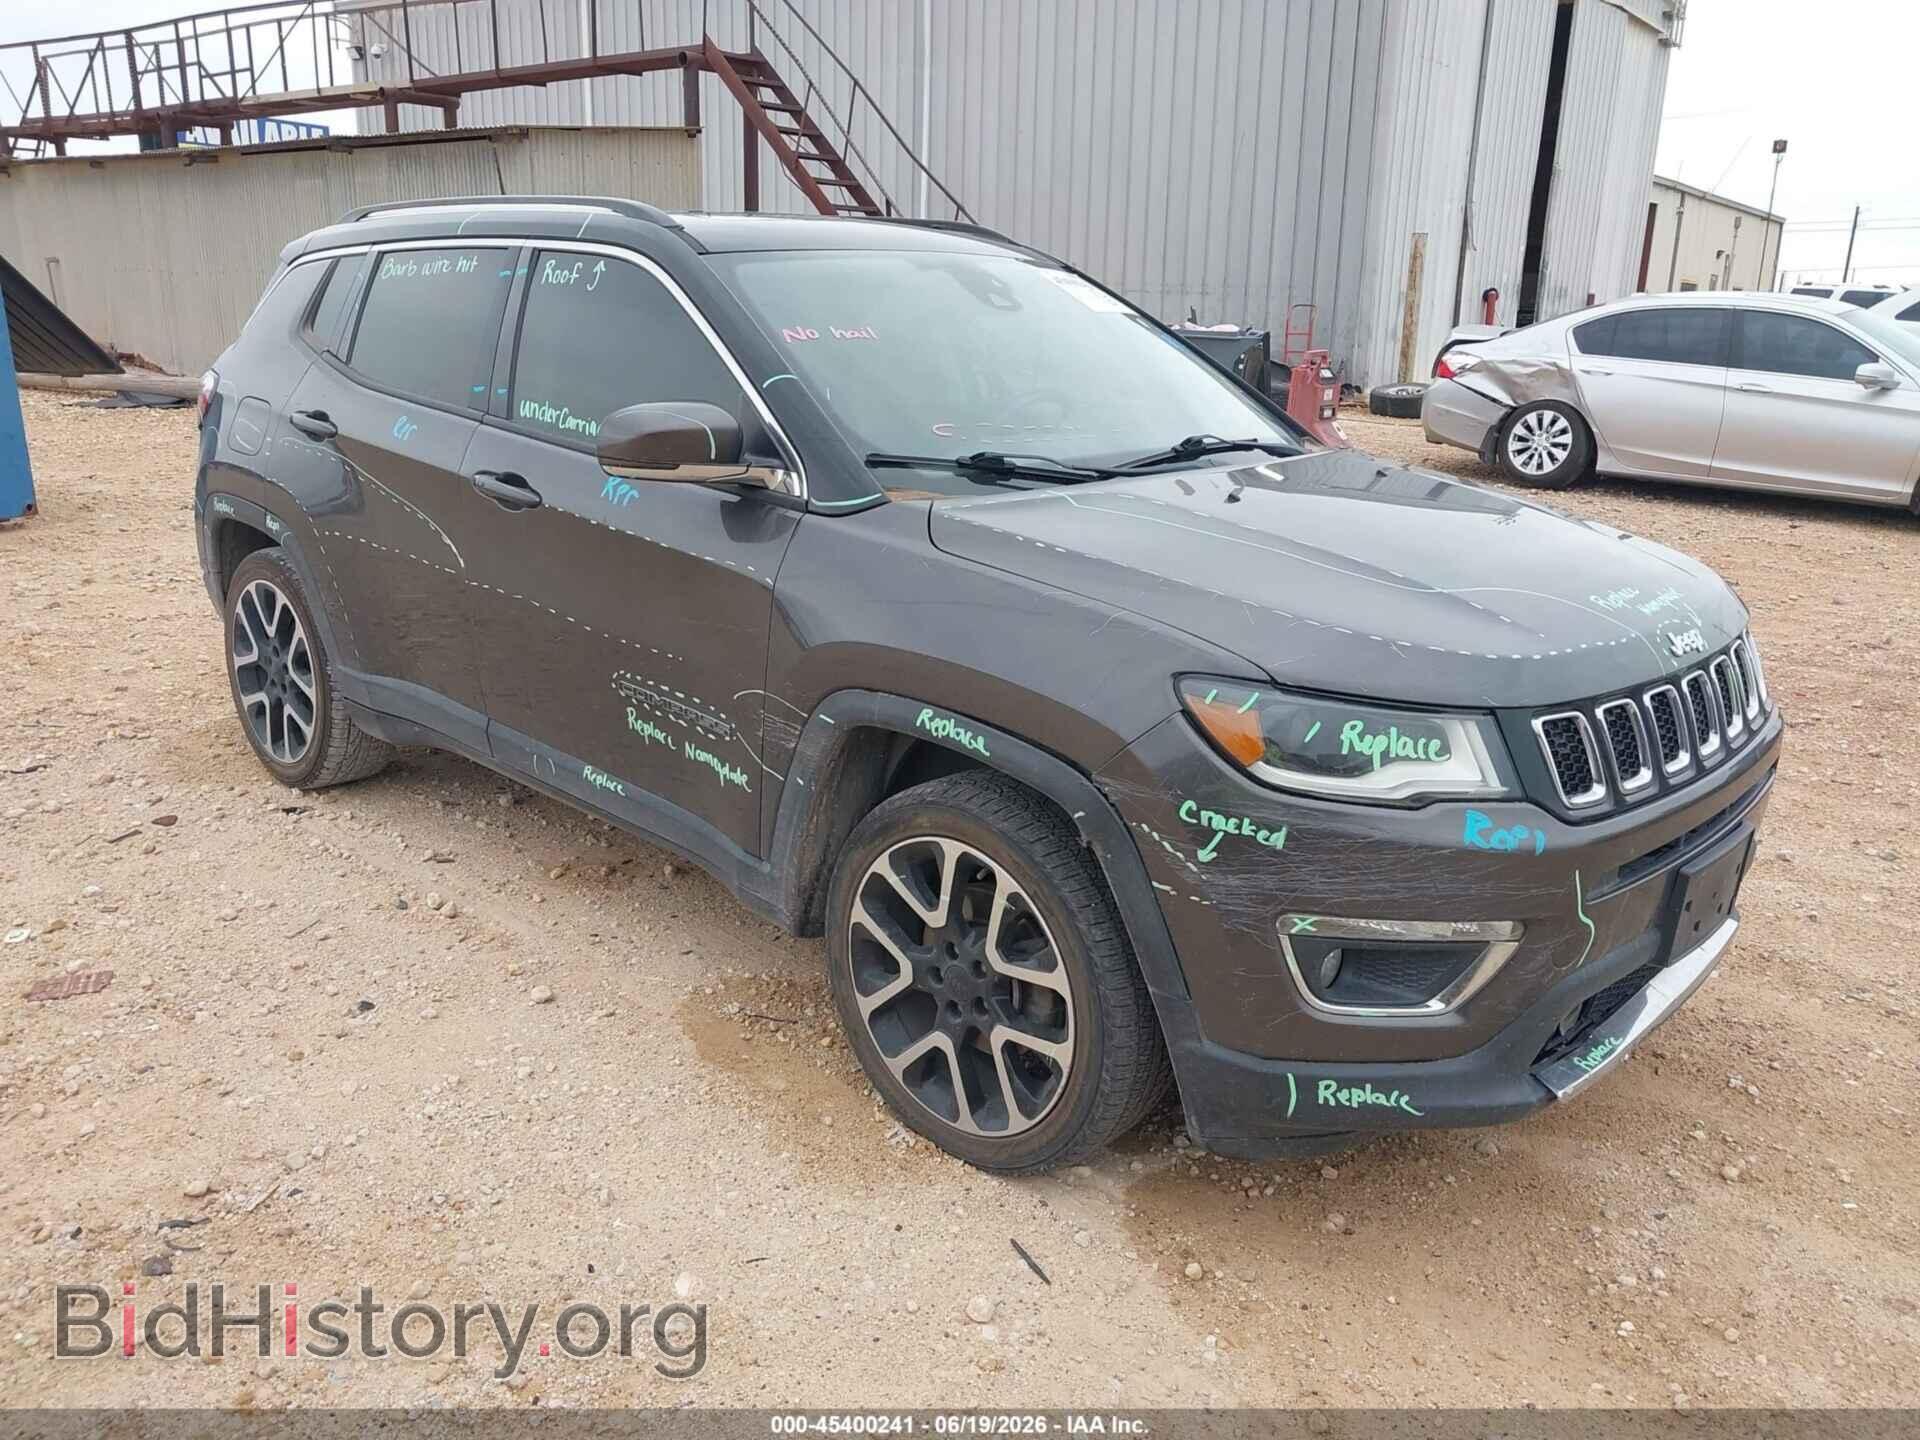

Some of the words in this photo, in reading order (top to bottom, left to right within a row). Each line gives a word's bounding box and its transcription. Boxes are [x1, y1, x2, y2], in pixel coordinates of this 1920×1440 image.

[381, 258, 417, 279] Barb
[456, 255, 479, 273] hit
[541, 262, 583, 285] Roof
[783, 327, 820, 343] No
[830, 325, 880, 341] hail
[1666, 628, 1705, 657] Jeep
[626, 707, 676, 750] Replace
[685, 741, 752, 793] Nameplate
[916, 707, 990, 757] Replace
[1339, 719, 1452, 771] Replace
[583, 765, 627, 797] Replace
[1178, 799, 1288, 850] Cracked
[1573, 1036, 1624, 1072] Replace
[1317, 1079, 1426, 1116] Replace
